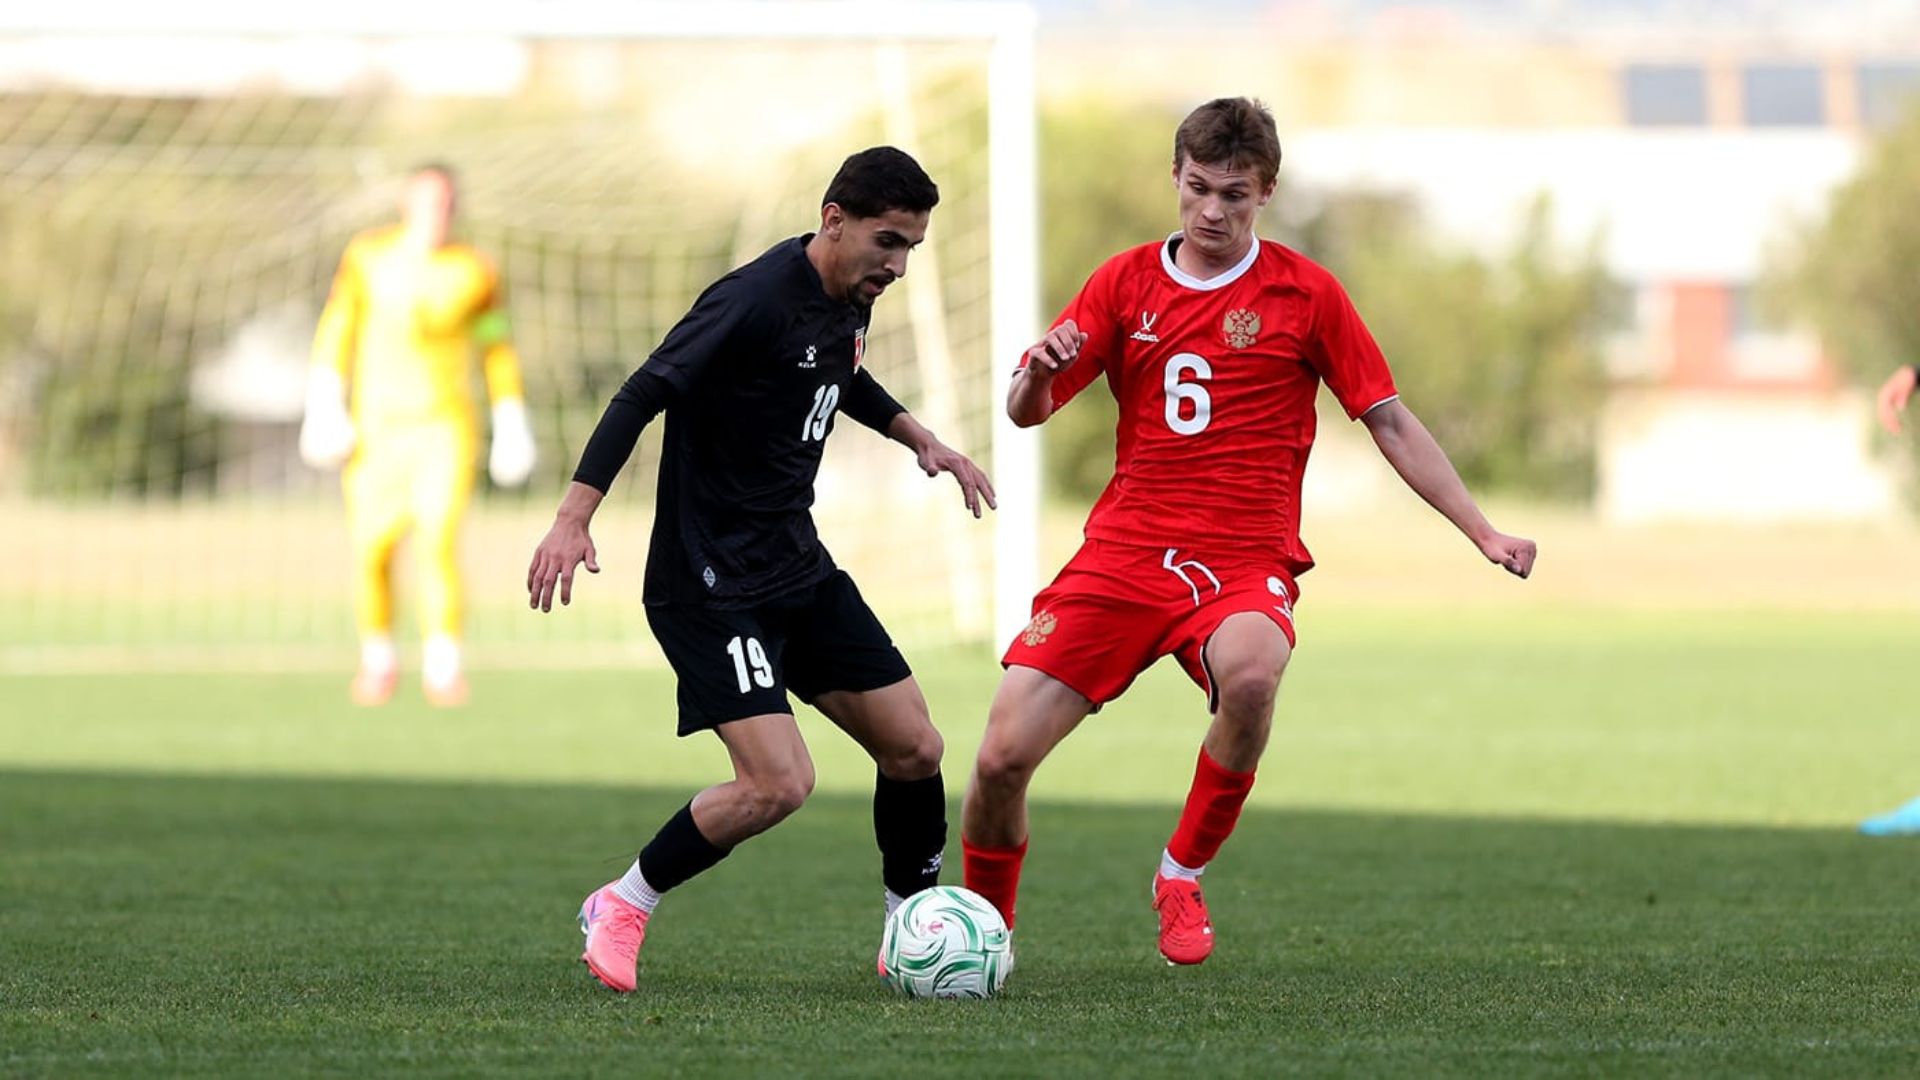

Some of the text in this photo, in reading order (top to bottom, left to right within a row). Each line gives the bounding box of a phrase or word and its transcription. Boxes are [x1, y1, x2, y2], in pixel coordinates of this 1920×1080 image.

[802, 384, 840, 441] 19
[1164, 353, 1212, 435] 6
[726, 636, 775, 694] 19
